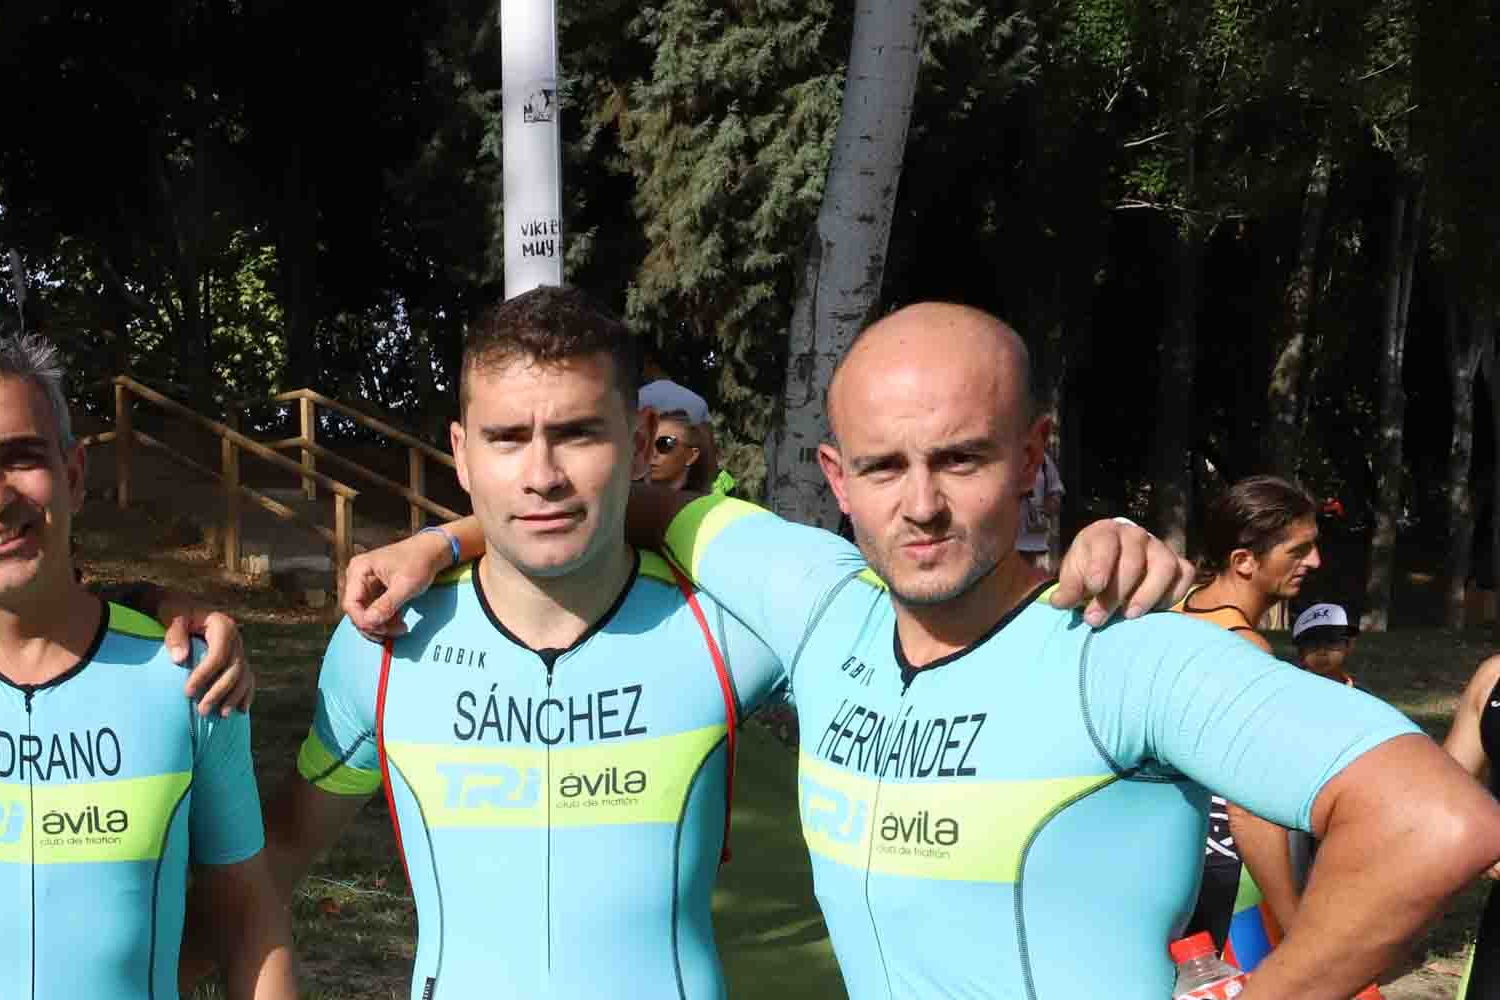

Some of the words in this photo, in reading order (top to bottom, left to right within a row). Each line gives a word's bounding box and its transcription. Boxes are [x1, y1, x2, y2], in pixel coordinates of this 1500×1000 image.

[522, 240, 554, 257] MUY
[432, 644, 488, 670] GOBIK
[453, 682, 648, 746] SÁNCHEZ
[816, 699, 987, 779] HERNÁNDEZ
